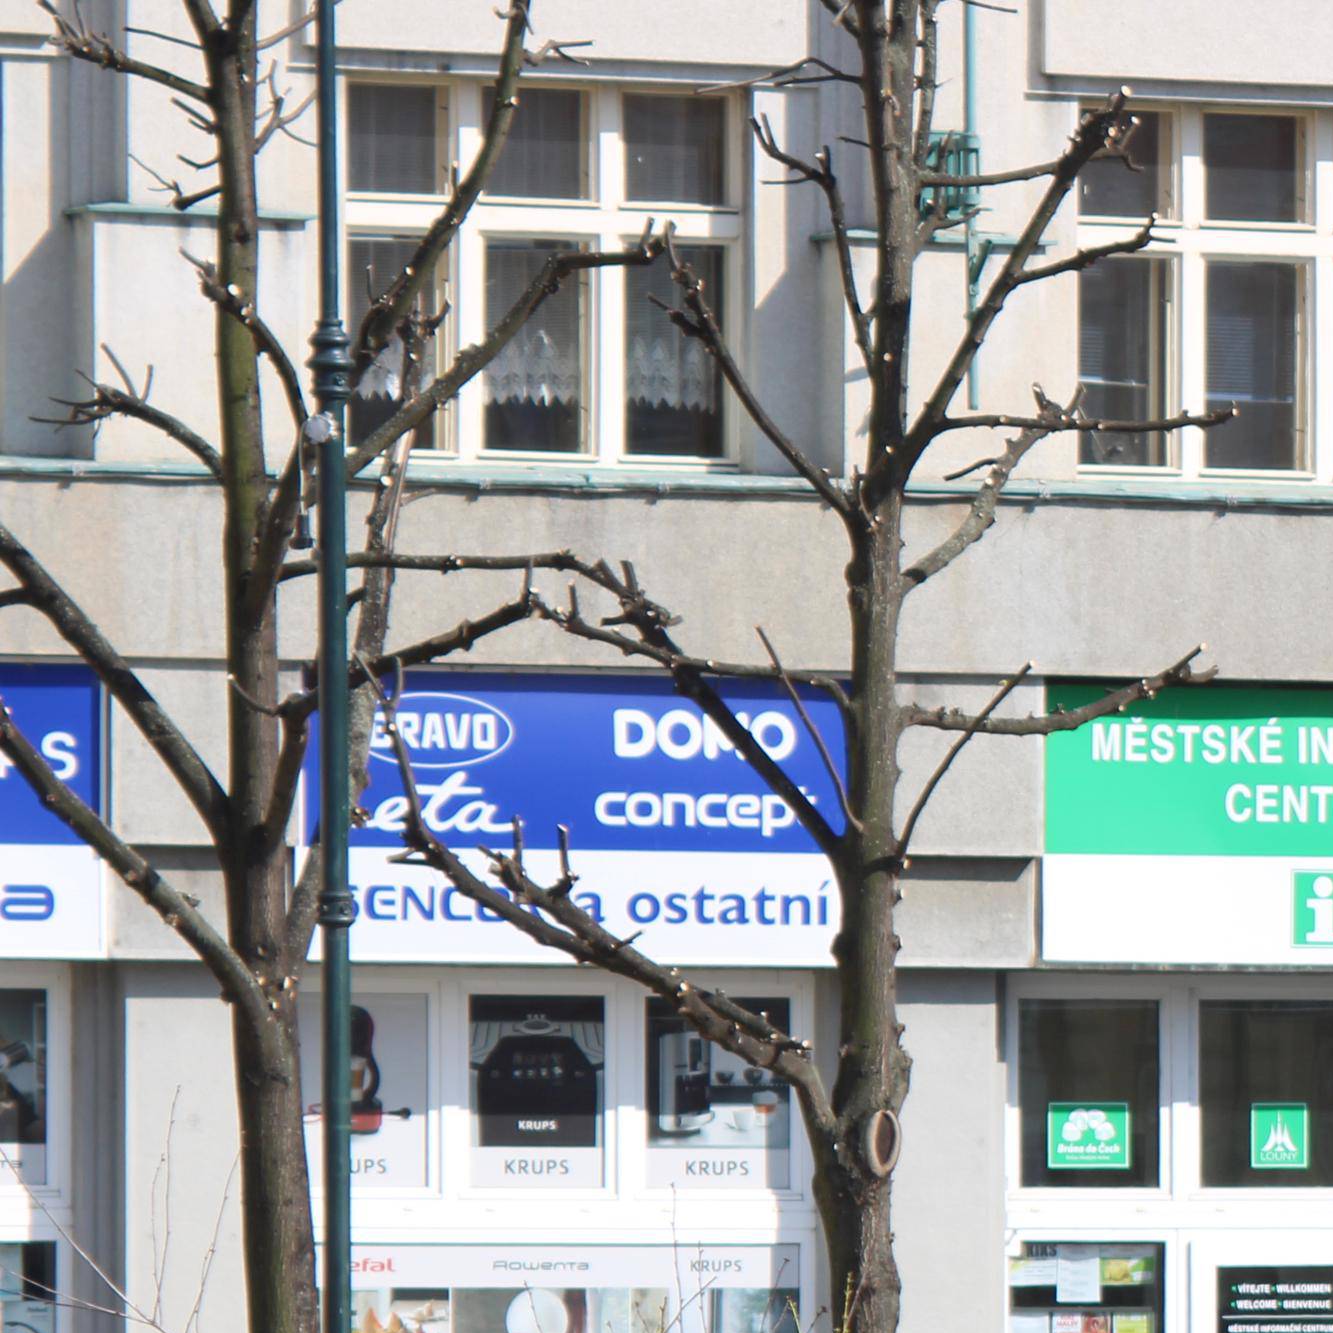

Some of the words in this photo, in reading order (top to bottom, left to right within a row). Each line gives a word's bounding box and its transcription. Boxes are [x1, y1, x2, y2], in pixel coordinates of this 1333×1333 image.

[370, 711, 498, 750] BRAVO
[1091, 717, 1283, 764] MĚSTSKÉ
[350, 884, 547, 923] ENCO
[627, 880, 833, 926] ostatní
[518, 1119, 557, 1130] KRUPS
[1260, 1150, 1298, 1161] LOUNY
[350, 1158, 387, 1175] UPS
[504, 1159, 570, 1175] KRUPS
[685, 1160, 750, 1176] KRUPS
[350, 1257, 396, 1273] efal
[690, 1259, 743, 1273] KRUPS
[1237, 1282, 1270, 1294] VÍTEJTE
[1276, 1283, 1332, 1294] WILLKOMMEN
[1236, 1299, 1277, 1310] WELCOME
[1282, 1299, 1331, 1310] BIENVENUE
